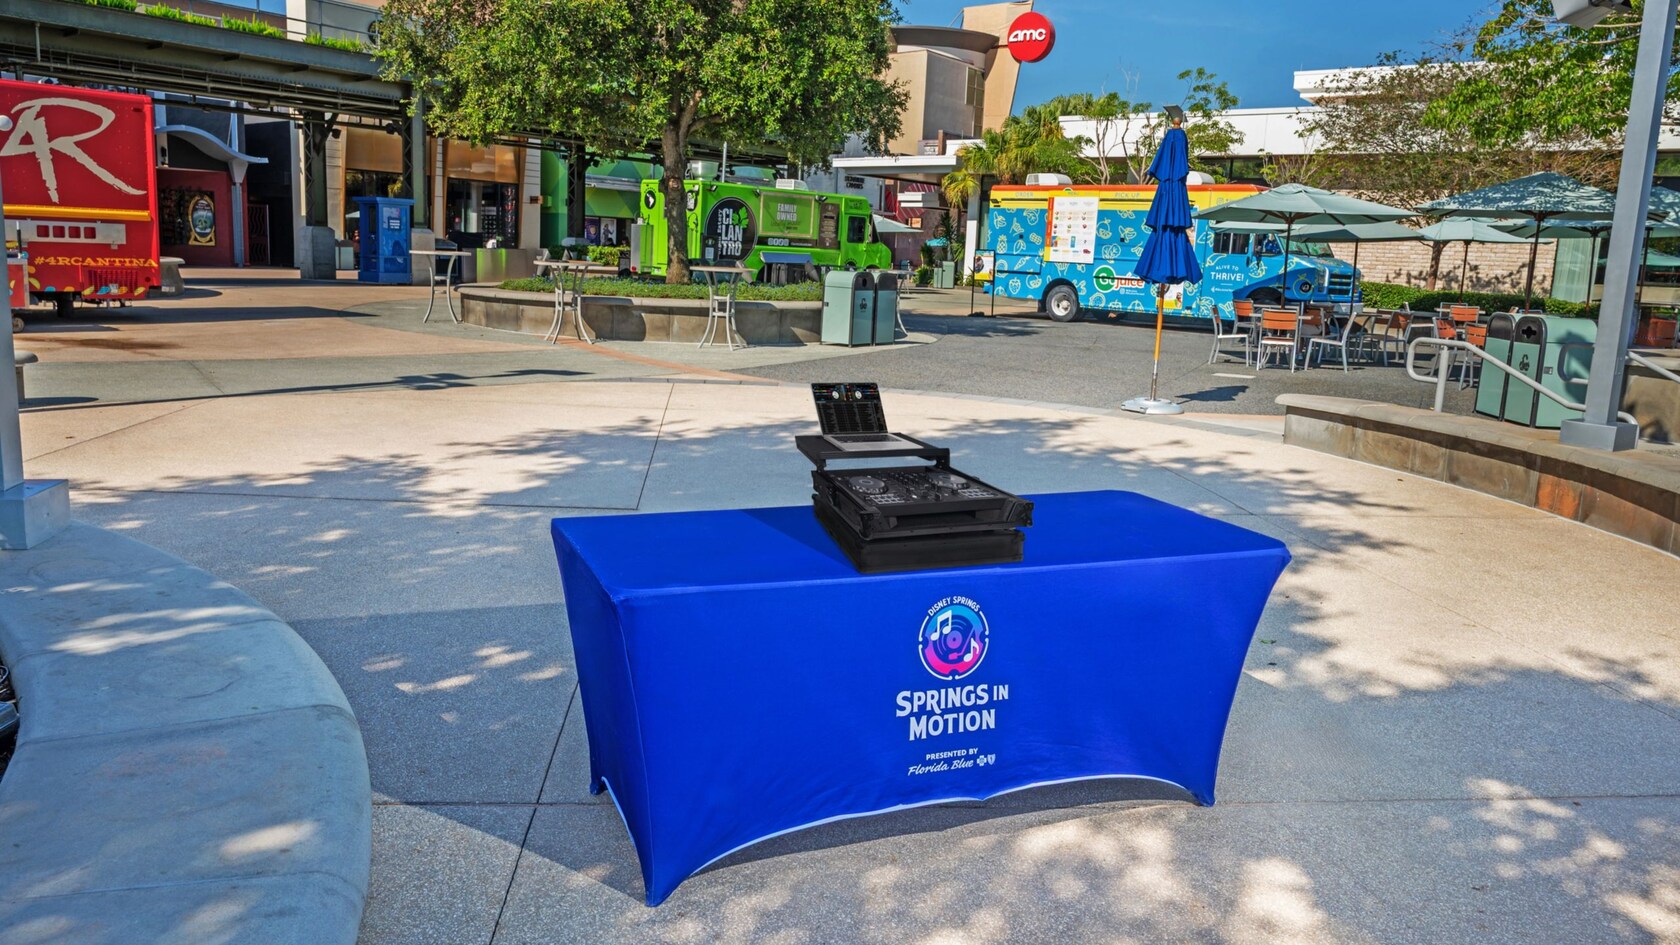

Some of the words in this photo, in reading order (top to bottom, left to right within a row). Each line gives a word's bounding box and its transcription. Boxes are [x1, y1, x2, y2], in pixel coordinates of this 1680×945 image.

[1008, 28, 1046, 42] amc
[777, 203, 797, 213] FAMILY
[776, 211, 797, 222] OWNED
[34, 255, 158, 268] #4RCANTINA
[1210, 271, 1245, 282] THRIVE!
[927, 597, 951, 617] DISNEY
[952, 595, 981, 613] SPRINGS
[895, 684, 989, 718] SPRINGS
[993, 684, 1009, 702] IN
[909, 708, 996, 742] MOTION
[926, 749, 967, 761] PRESENTED
[968, 747, 979, 756] BY
[907, 762, 950, 777] Florida
[950, 759, 974, 771] Blue
